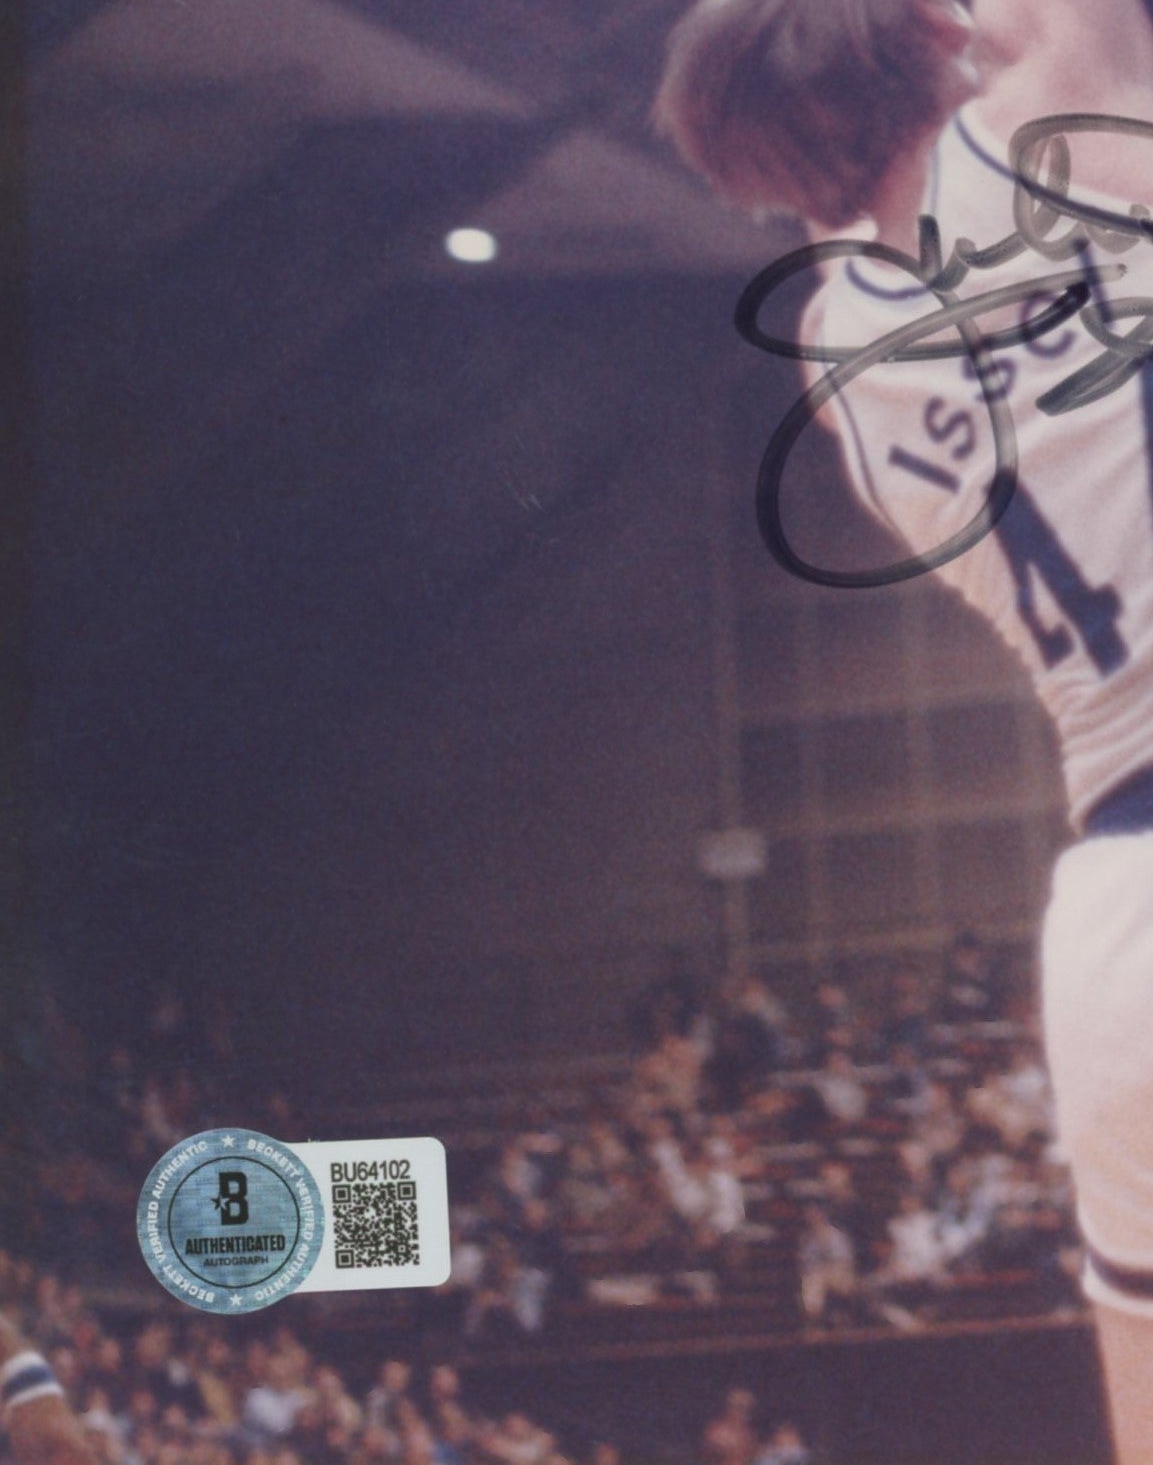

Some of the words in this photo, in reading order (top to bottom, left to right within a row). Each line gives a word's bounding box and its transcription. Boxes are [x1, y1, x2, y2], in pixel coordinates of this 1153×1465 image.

[152, 1140, 208, 1199] AUTHENTIC
[246, 1139, 300, 1177] BECKETT
[330, 1159, 411, 1183] BU64102
[185, 1234, 286, 1255] AUTHENTICATED
[203, 1255, 269, 1267] AUTOGRAPH
[163, 1264, 215, 1303] BECKETT
[255, 1243, 310, 1301] AUTHENTIC
